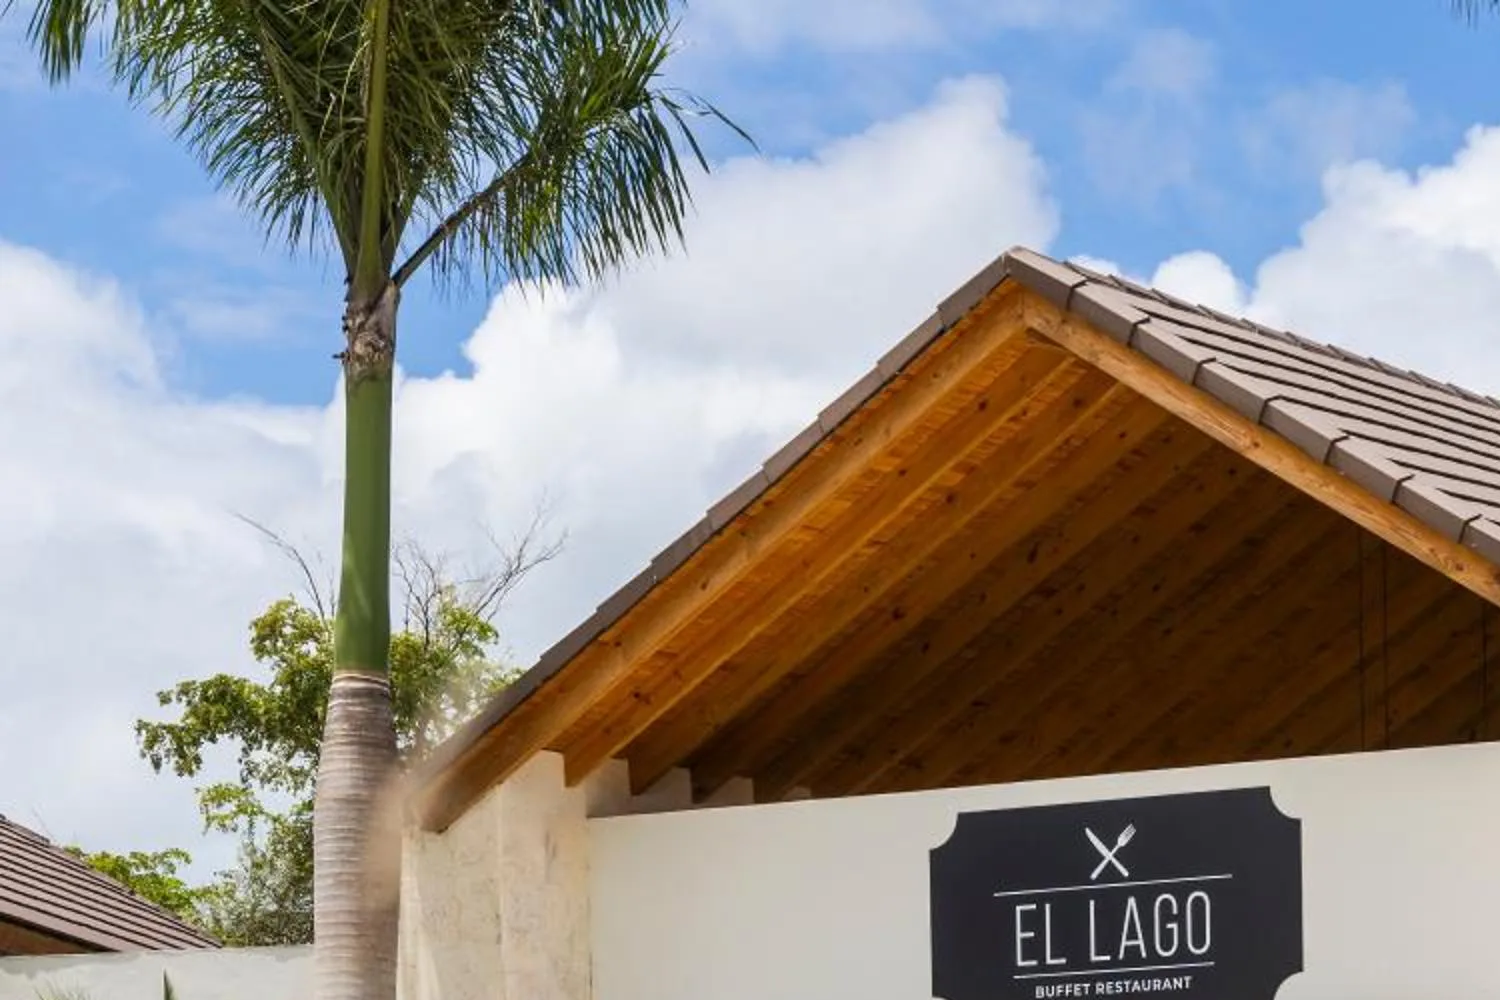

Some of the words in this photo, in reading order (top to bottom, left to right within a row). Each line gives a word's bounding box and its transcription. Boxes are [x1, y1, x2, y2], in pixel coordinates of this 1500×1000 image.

[1015, 903, 1067, 967] EL
[1089, 890, 1211, 962] LAGO
[1035, 983, 1091, 999] BUFFET
[1095, 976, 1192, 995] RESTAURANT
